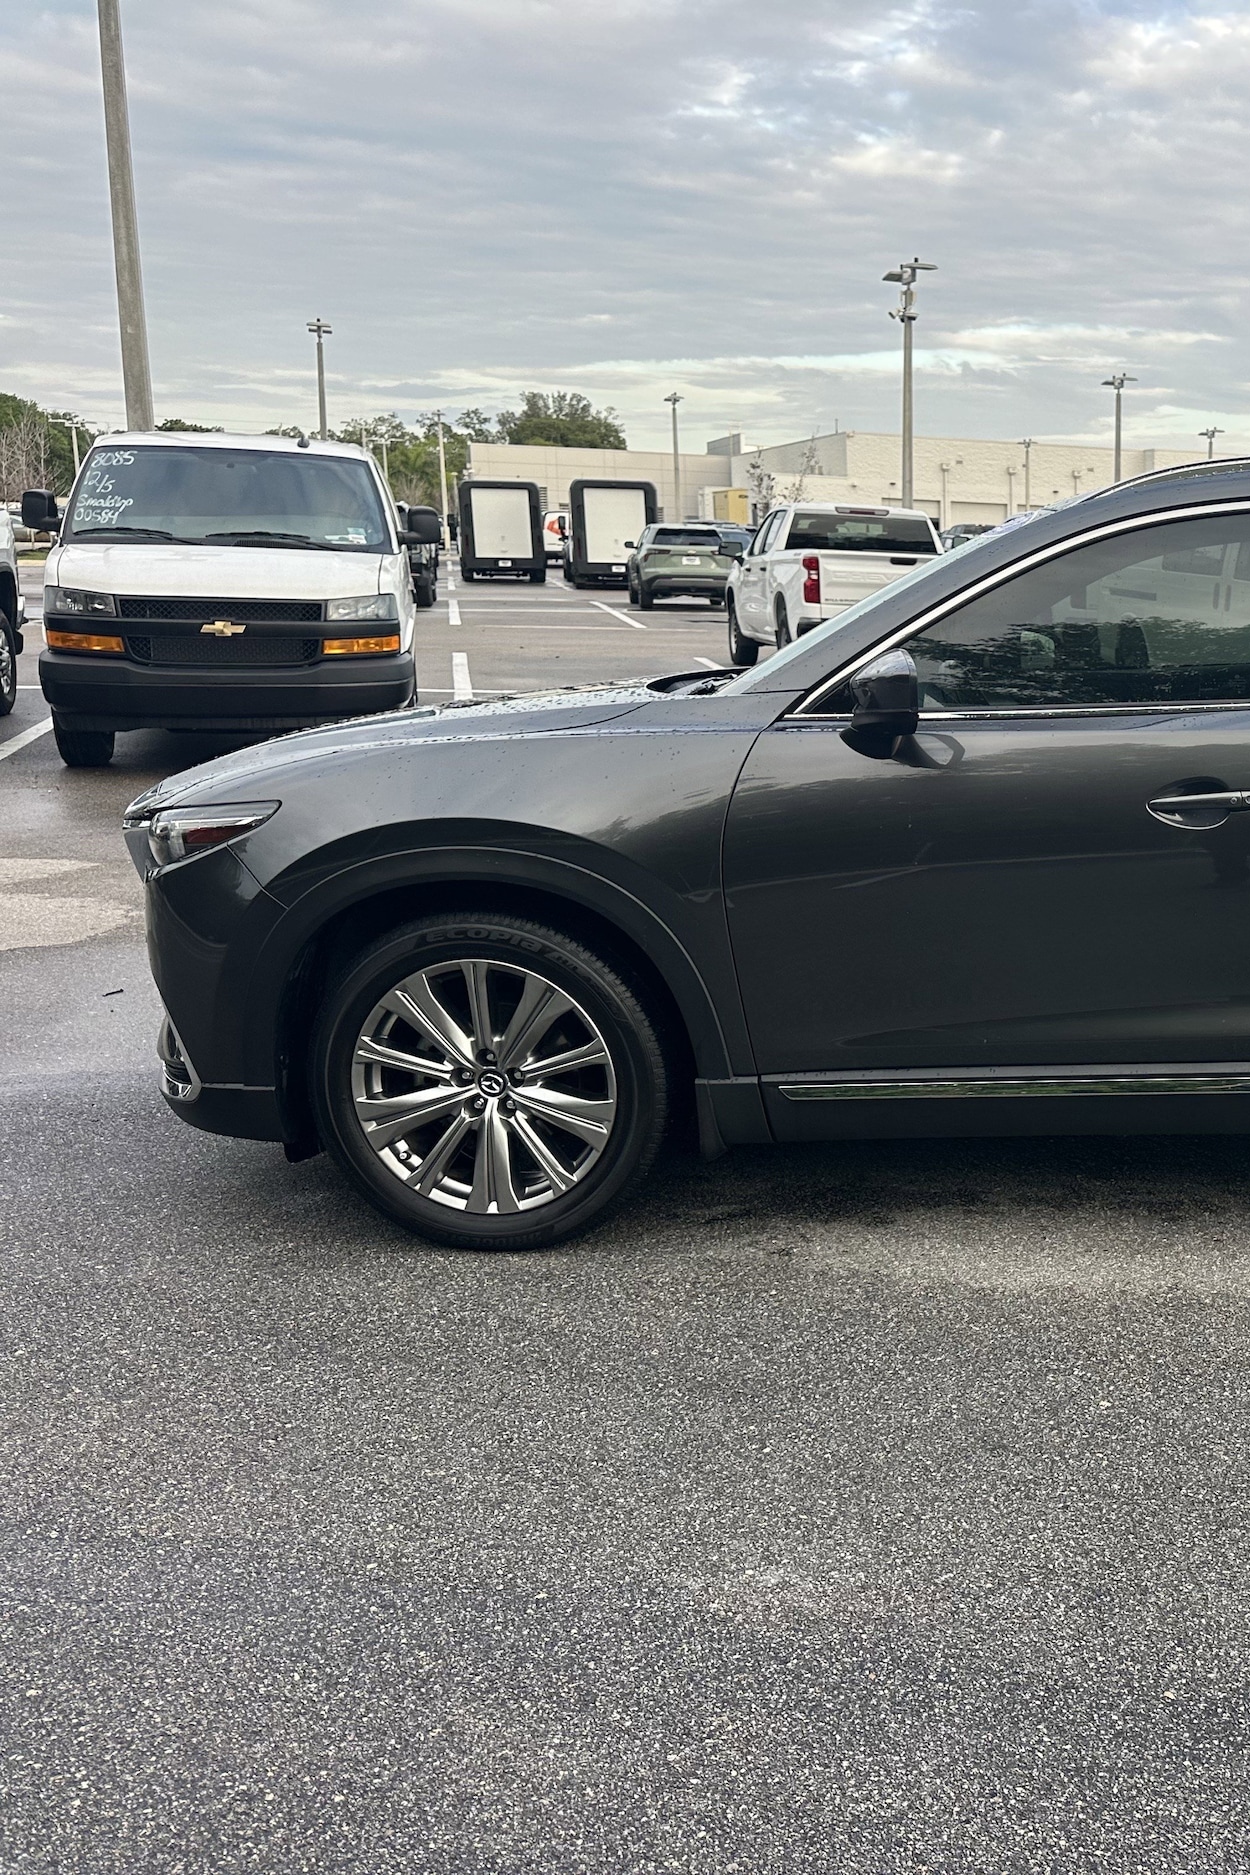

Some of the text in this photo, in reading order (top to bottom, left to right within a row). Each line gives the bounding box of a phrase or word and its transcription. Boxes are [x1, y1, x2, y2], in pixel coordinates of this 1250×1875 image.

[91, 450, 138, 468] 8085
[84, 470, 116, 493] 12/5
[74, 508, 120, 524] 00584
